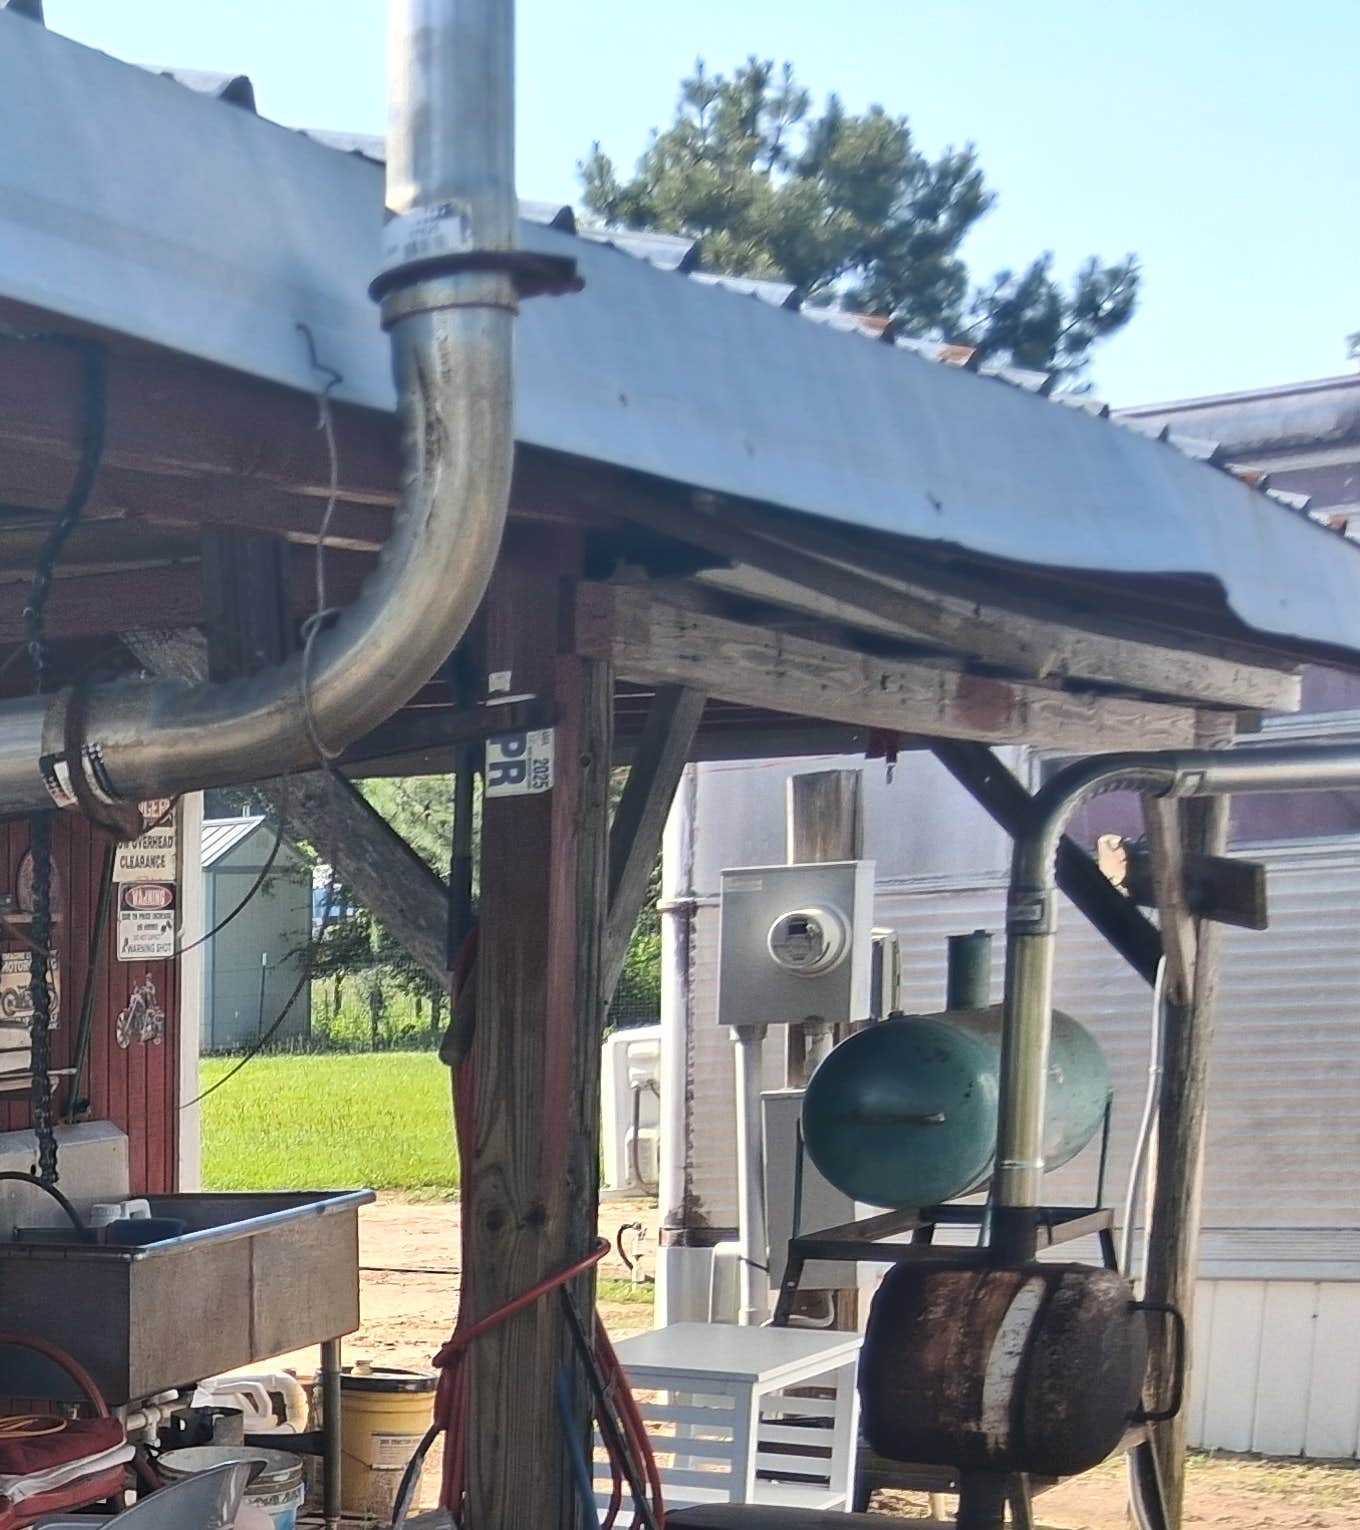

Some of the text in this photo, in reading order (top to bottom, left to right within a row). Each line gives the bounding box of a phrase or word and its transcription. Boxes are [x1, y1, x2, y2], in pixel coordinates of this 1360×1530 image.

[533, 758, 550, 789] 2025
[119, 855, 166, 869] CLEARANCE
[131, 889, 166, 906] WARNING
